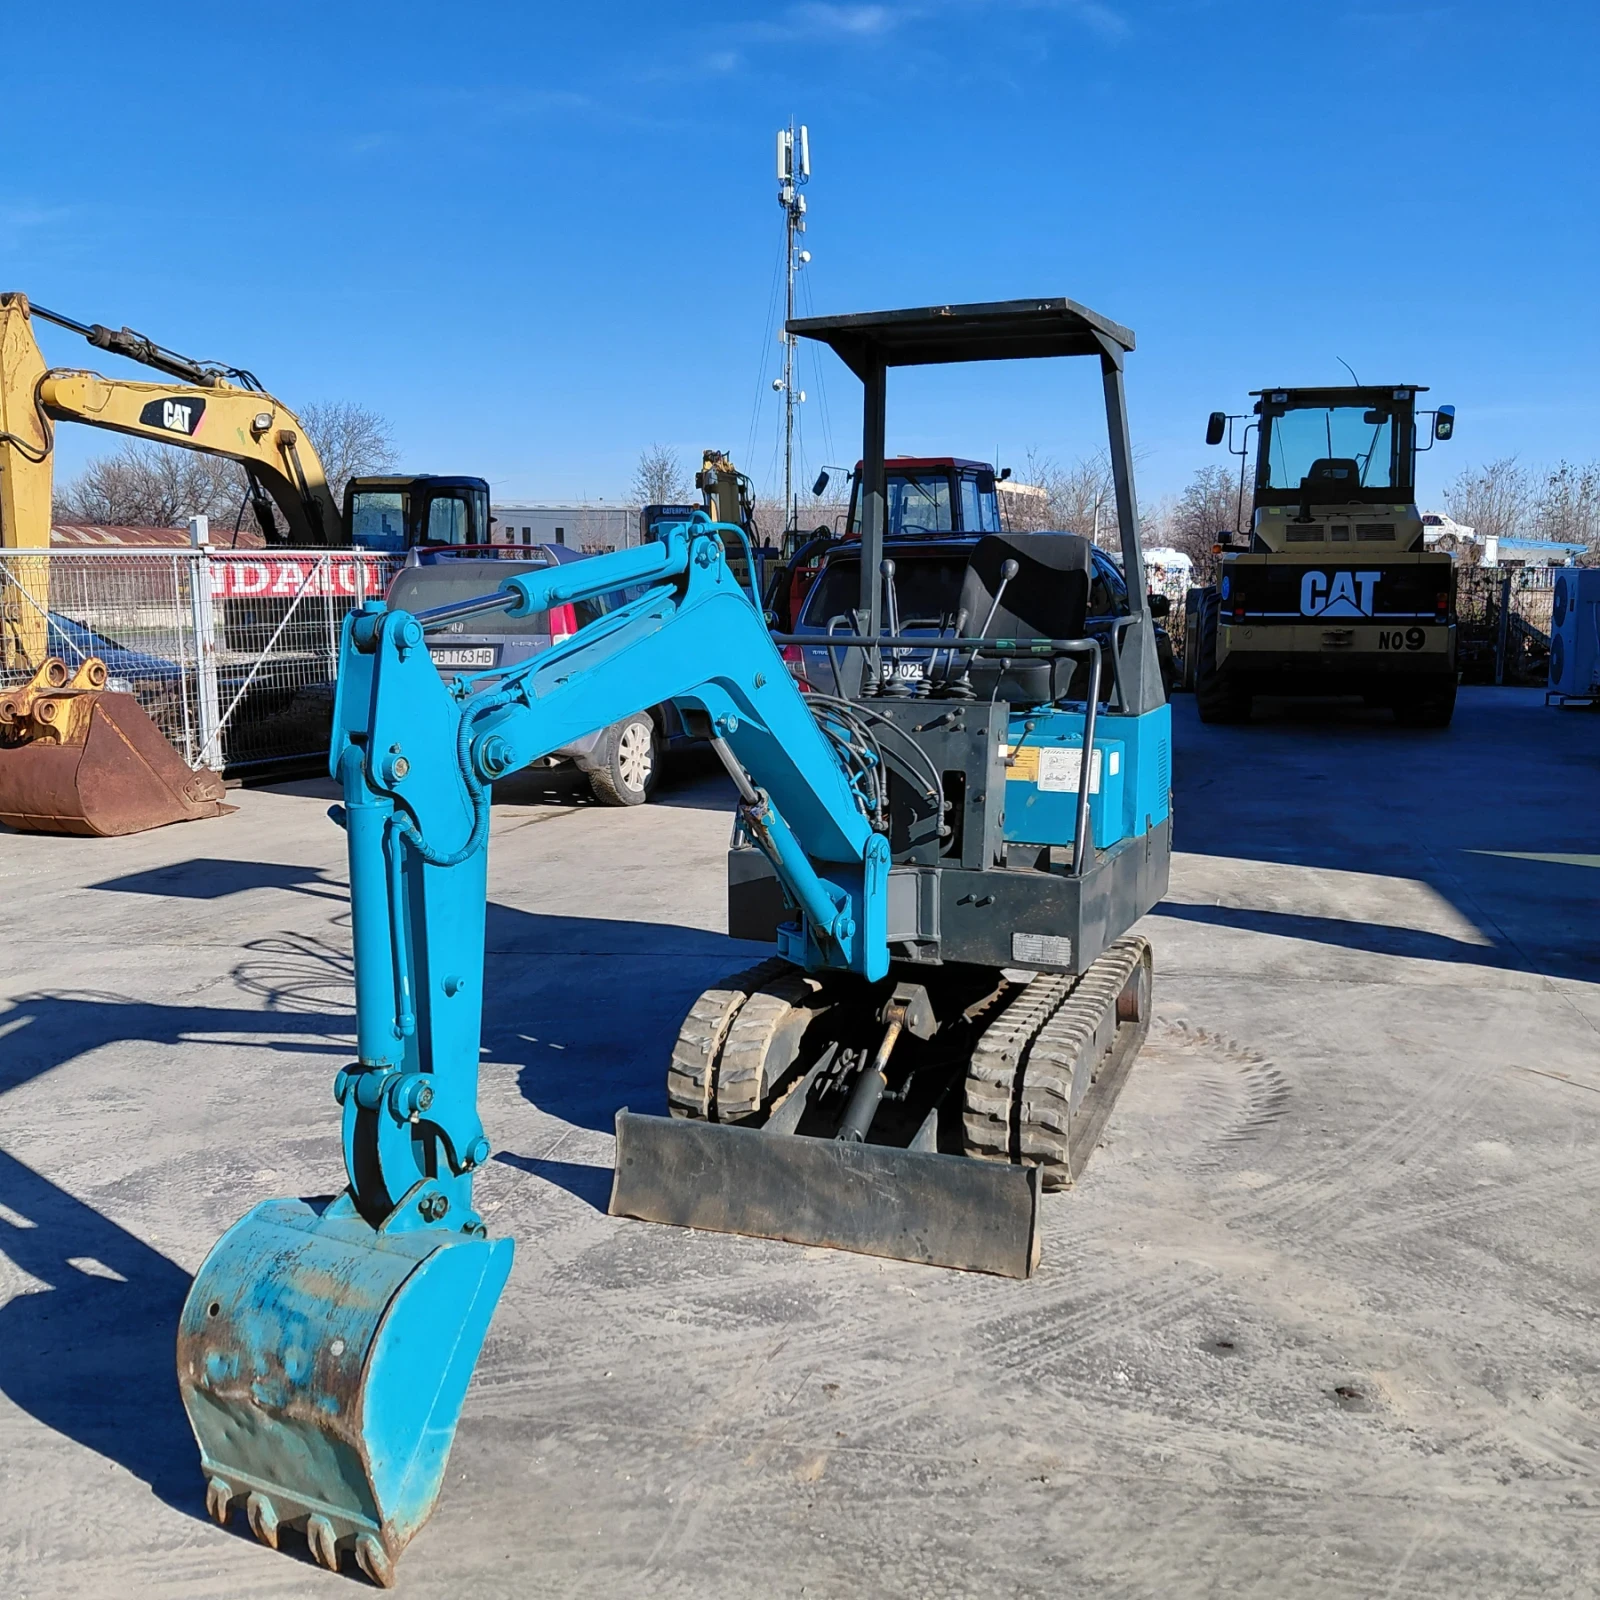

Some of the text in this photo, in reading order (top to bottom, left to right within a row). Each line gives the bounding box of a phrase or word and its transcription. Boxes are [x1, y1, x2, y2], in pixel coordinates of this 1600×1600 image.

[163, 401, 192, 433] CAT
[1300, 571, 1381, 617] CAT
[449, 650, 475, 663] 1163
[476, 650, 492, 664] HB
